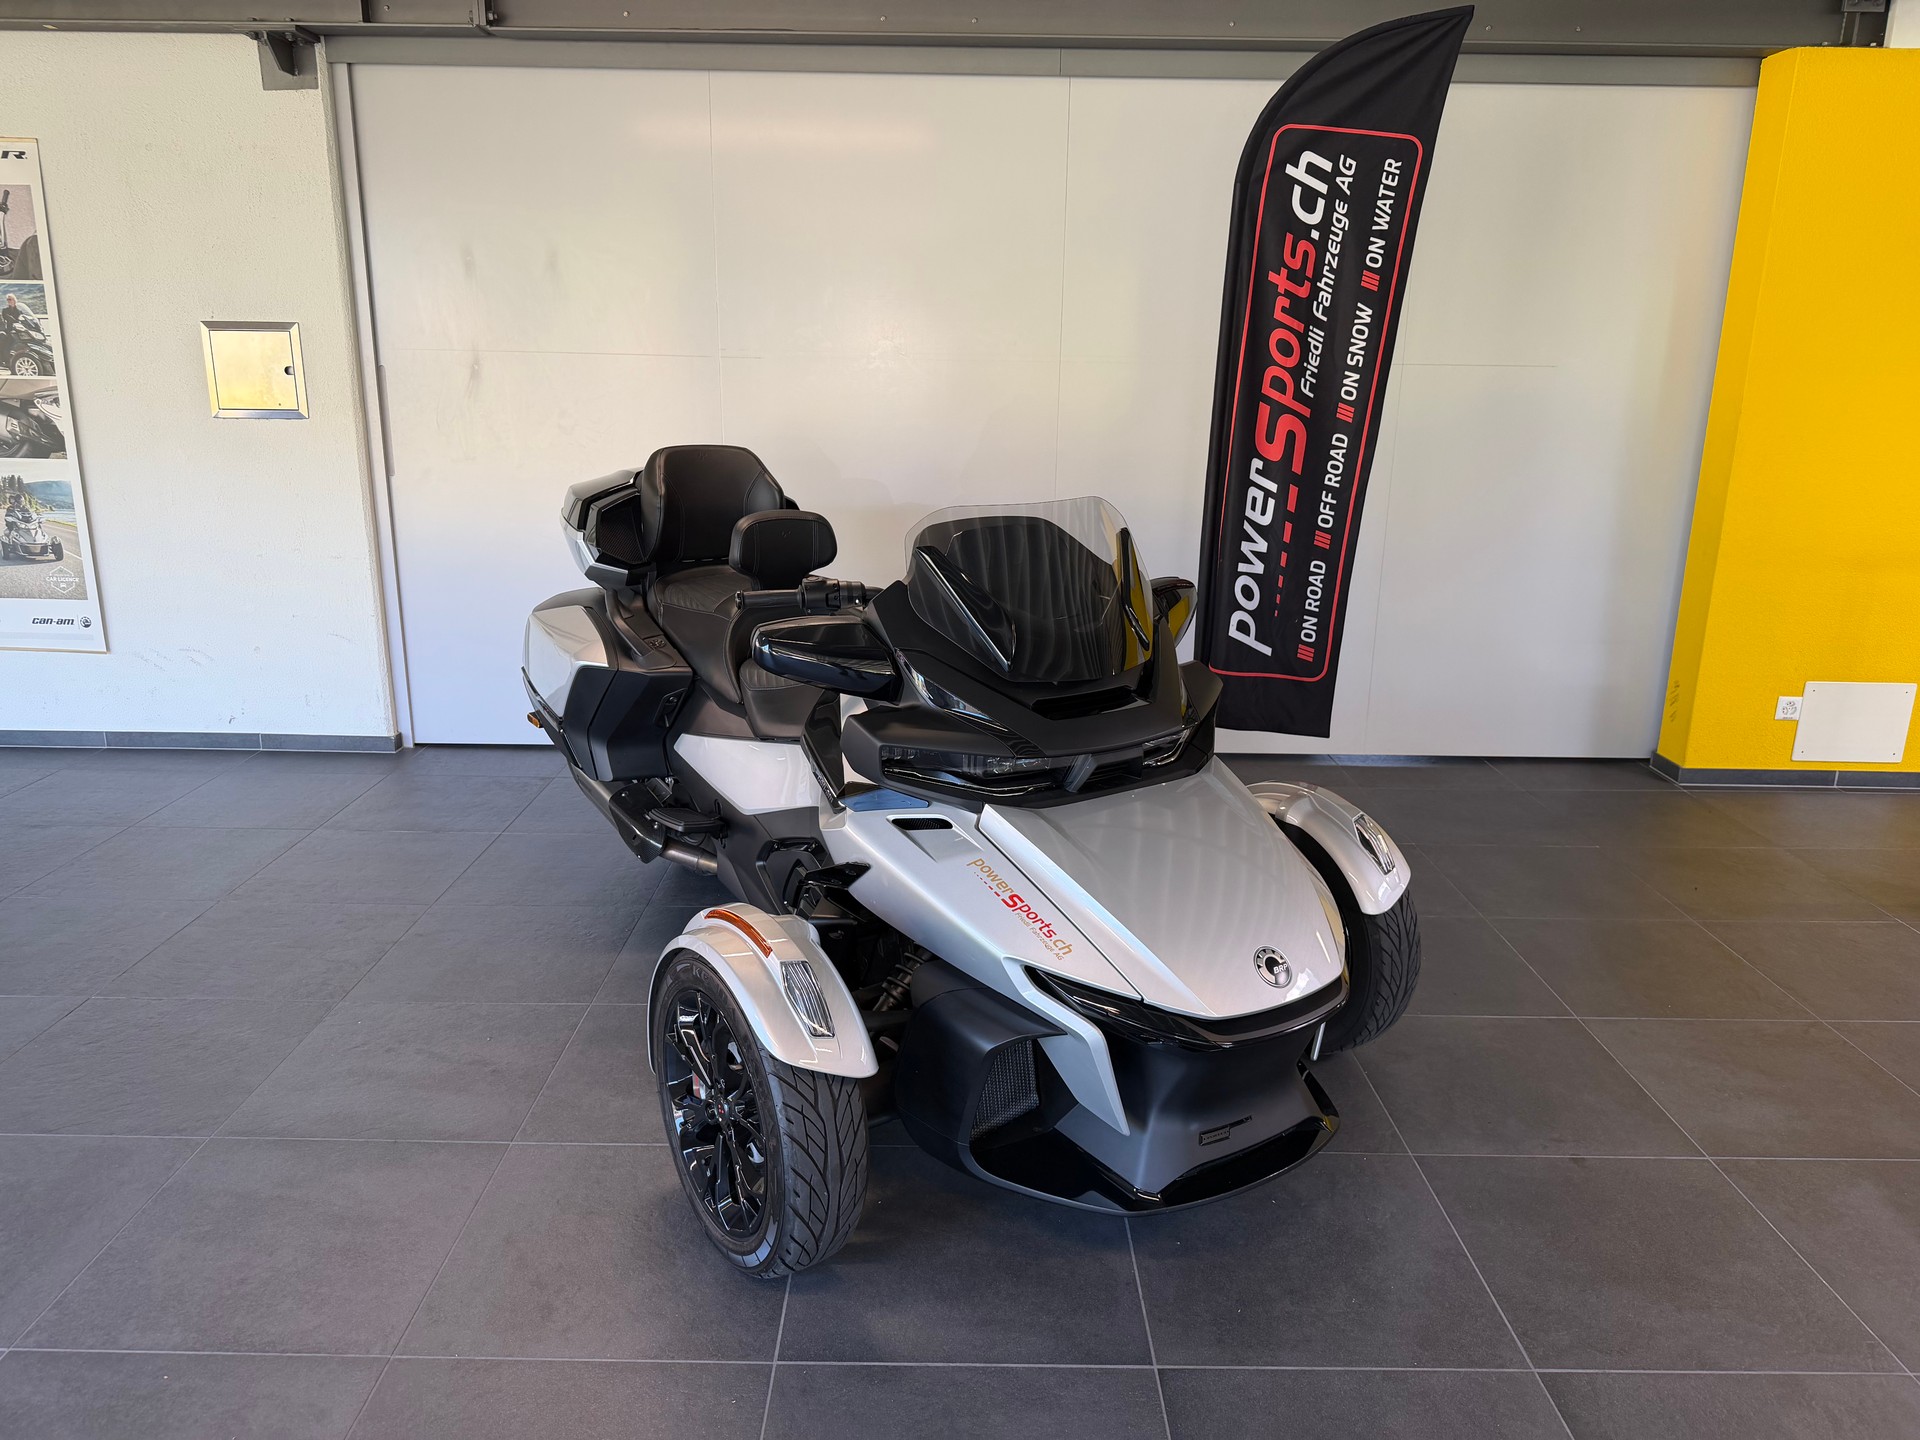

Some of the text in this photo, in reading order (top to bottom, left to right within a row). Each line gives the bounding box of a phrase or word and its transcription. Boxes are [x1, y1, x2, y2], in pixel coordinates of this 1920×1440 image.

[1301, 154, 1357, 398] Friedli Fahrzeuge AG
[1228, 150, 1333, 657] powerSports.ch
[1300, 158, 1402, 643] ON ROAD OFF ROAD ON SNOW ON WATER
[32, 617, 75, 625] can-am
[966, 858, 1073, 956] powerSports.ch
[1273, 963, 1288, 974] BRP
